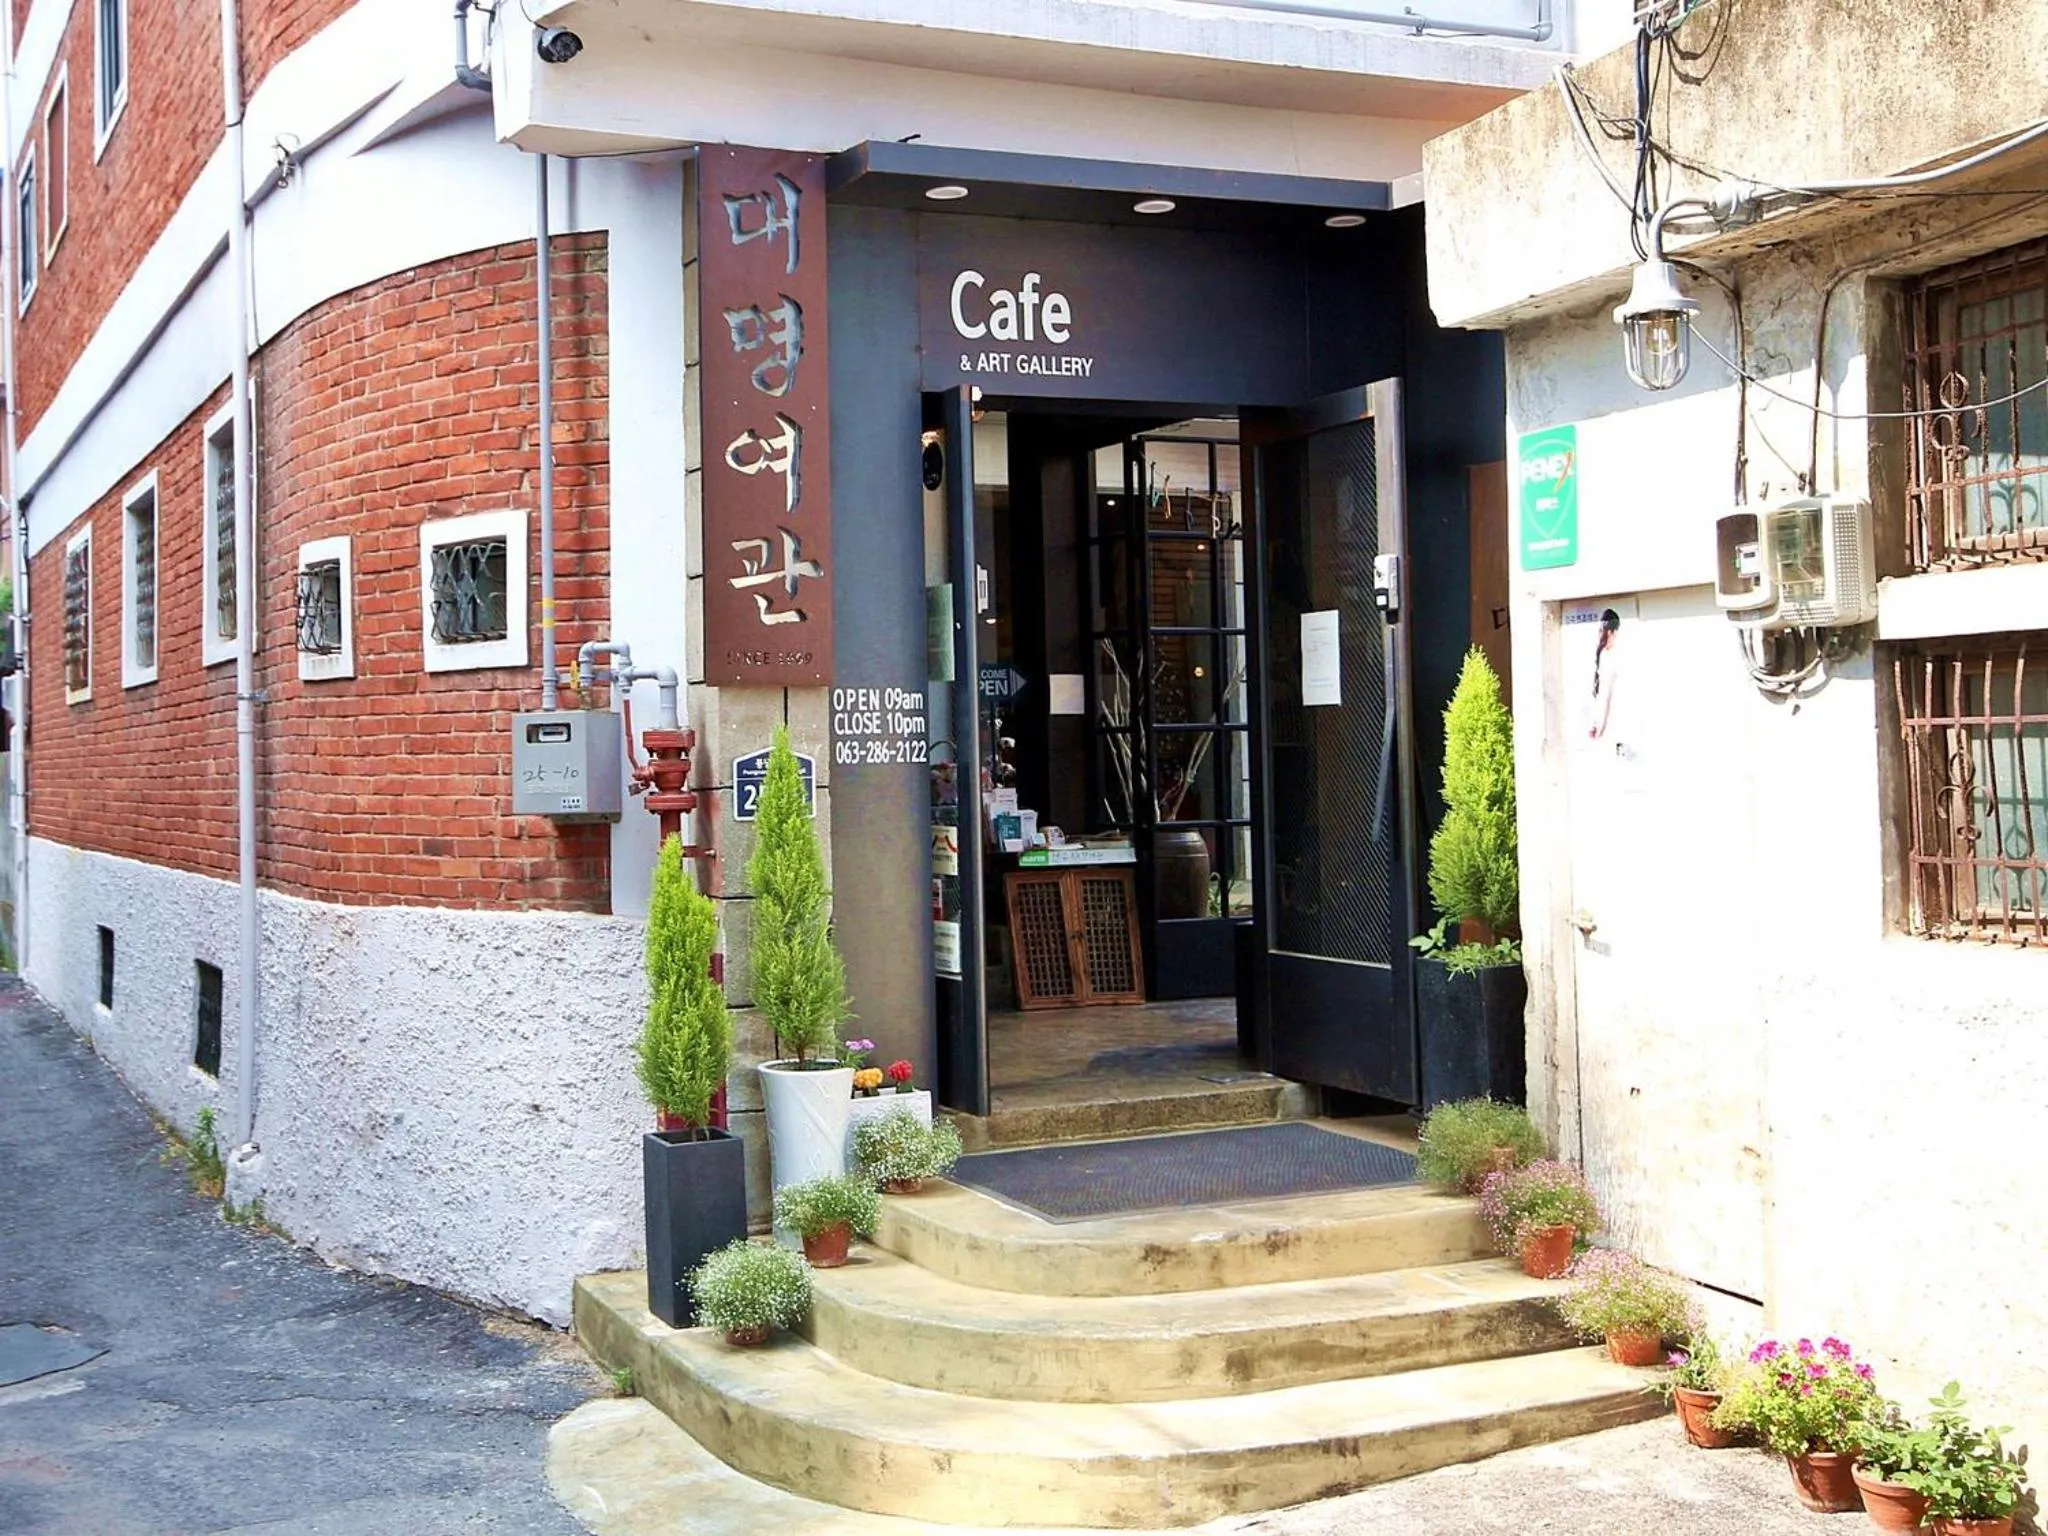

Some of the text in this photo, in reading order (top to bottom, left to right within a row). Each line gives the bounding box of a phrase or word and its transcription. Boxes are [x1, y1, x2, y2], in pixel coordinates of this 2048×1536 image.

[951, 270, 1071, 344] Cafe
[960, 352, 1094, 377] & ART GALLERY
[723, 172, 824, 626] 대명여관
[833, 687, 924, 711] OPEN 09am
[834, 712, 926, 738] CLOSE 10pm
[836, 740, 928, 764] 063-286-2122
